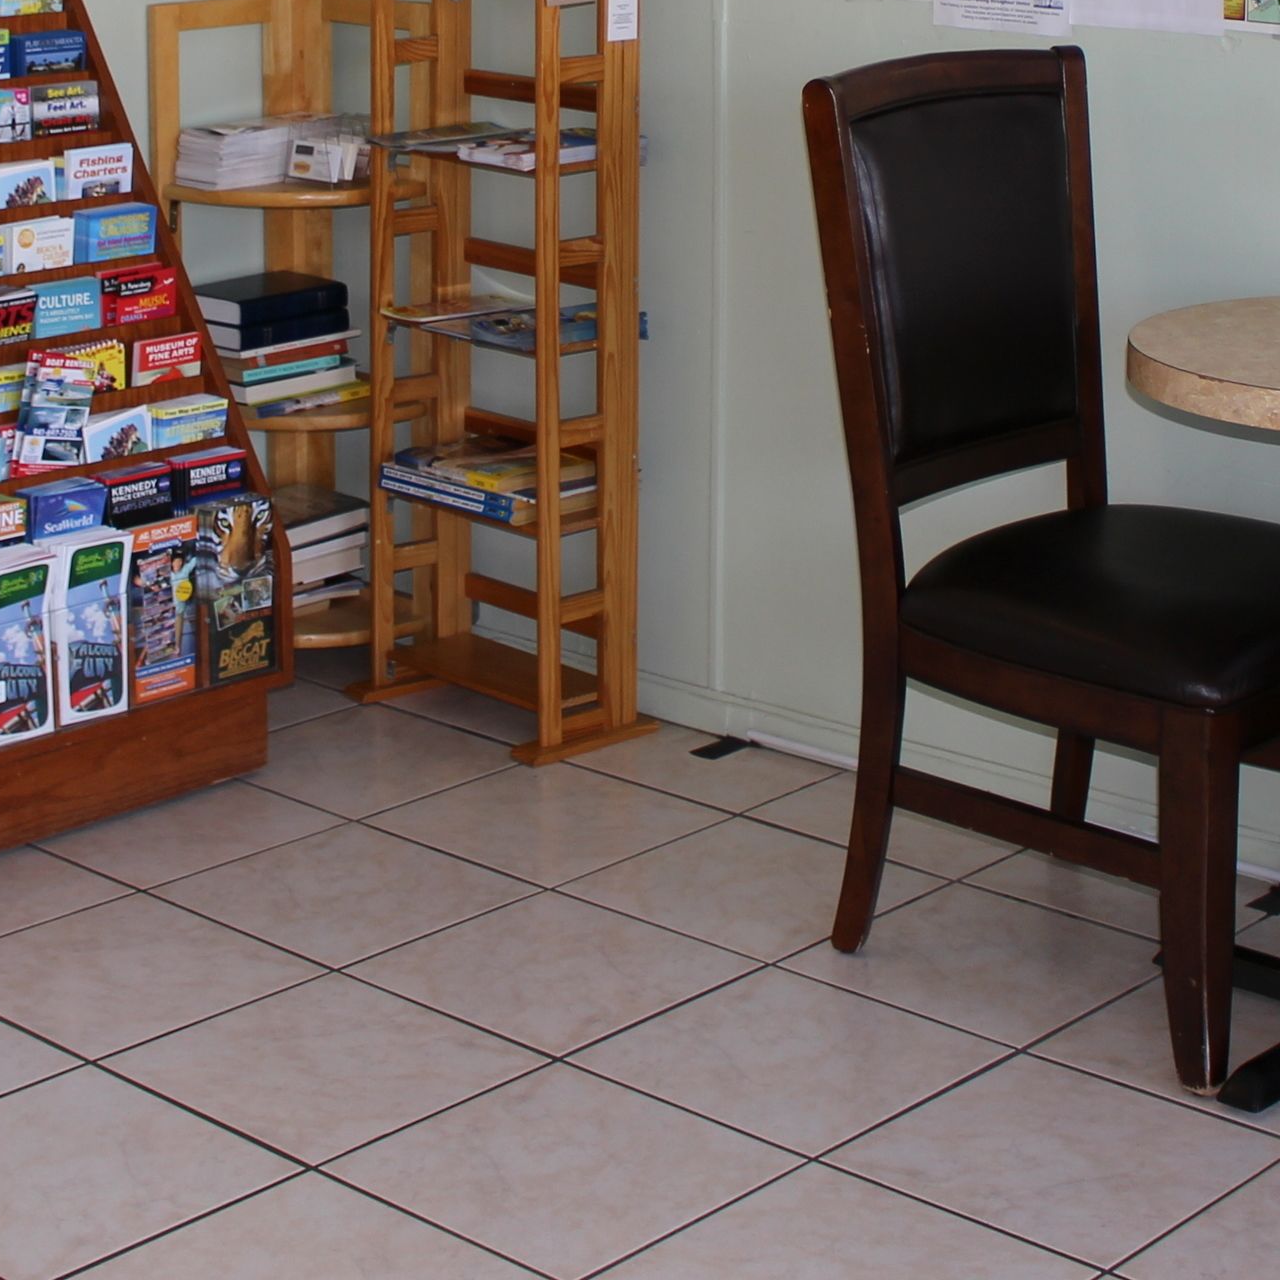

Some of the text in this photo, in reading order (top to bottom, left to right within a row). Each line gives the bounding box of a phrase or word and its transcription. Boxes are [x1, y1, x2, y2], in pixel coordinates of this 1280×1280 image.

[48, 86, 84, 98] See Art.
[48, 101, 86, 112] Feel Art.
[79, 154, 124, 168] Fishing
[73, 165, 128, 179] Charters
[39, 292, 94, 309] CULTURE.
[139, 294, 169, 306] MUSIC.
[146, 339, 184, 354] MUSEUM
[148, 347, 194, 361] FINE ARTS
[45, 358, 64, 367] BOAT
[189, 463, 226, 480] KENNEDY
[190, 472, 226, 486] SPACE CENTER
[111, 479, 157, 496] KENNEDY
[111, 488, 157, 504] SPACE CENTER
[44, 513, 94, 535] SeaWorld
[169, 522, 193, 534] ZONE
[71, 656, 114, 678] FURY
